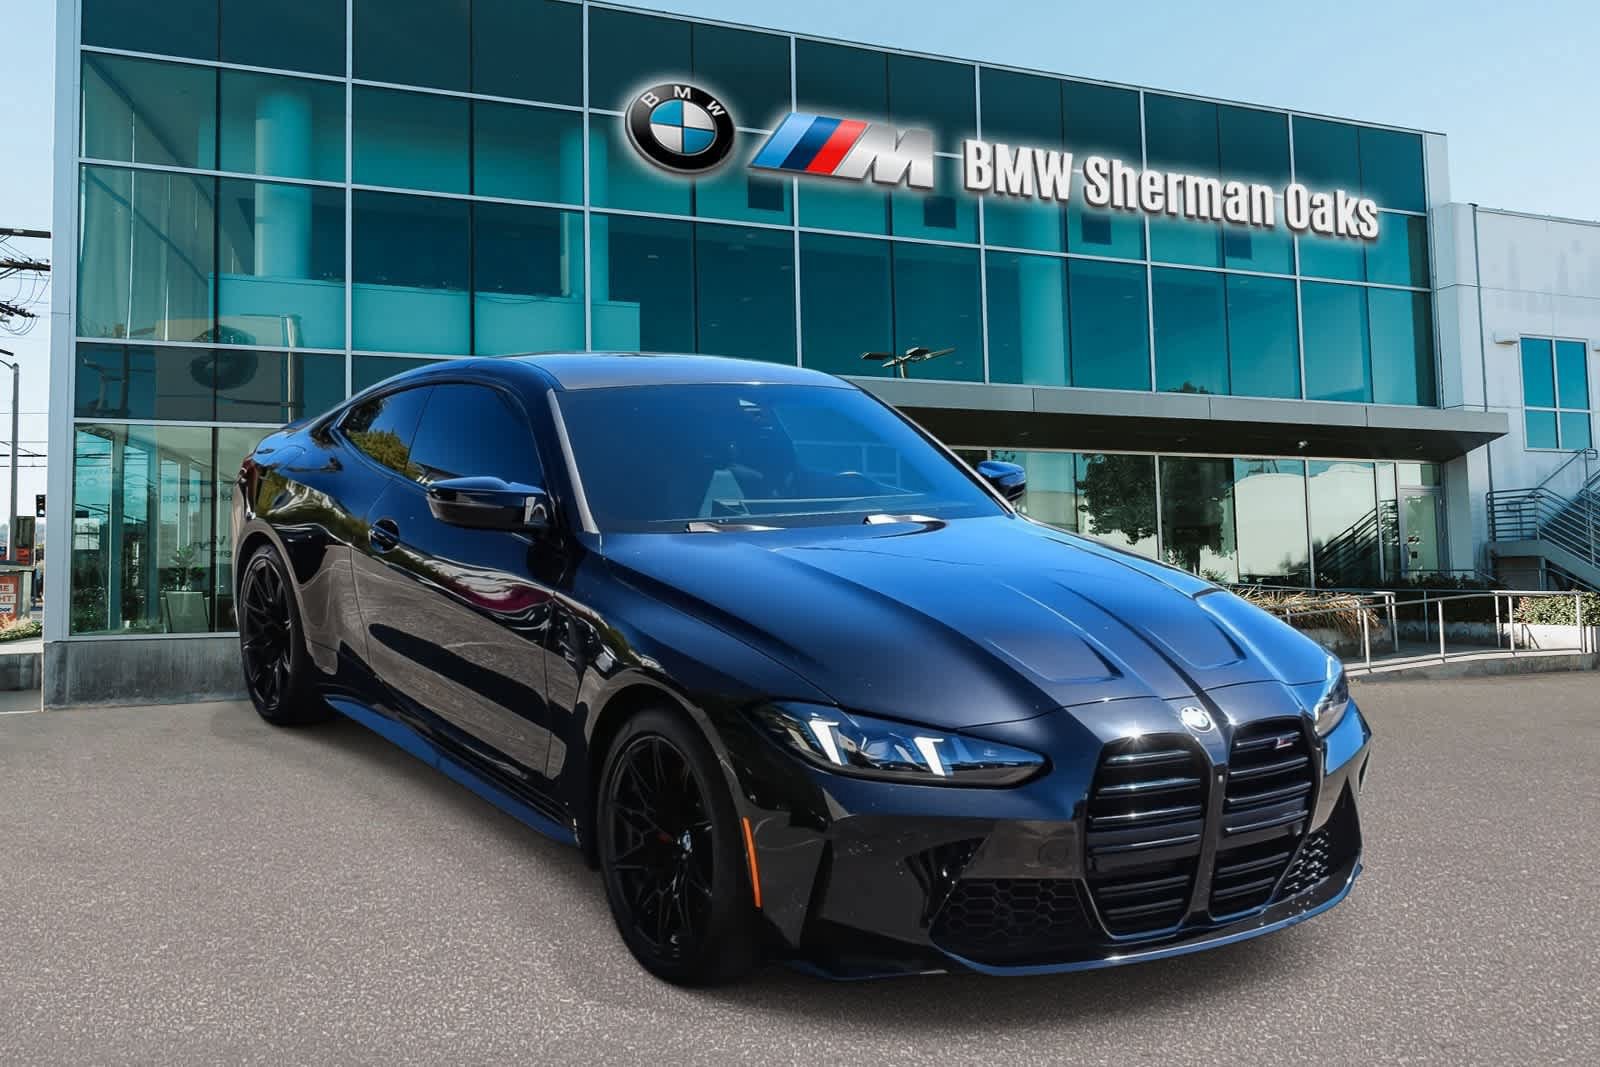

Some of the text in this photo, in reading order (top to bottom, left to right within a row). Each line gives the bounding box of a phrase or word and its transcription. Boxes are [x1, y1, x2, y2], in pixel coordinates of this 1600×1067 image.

[959, 139, 1379, 240] BMW Sherman Oaks
